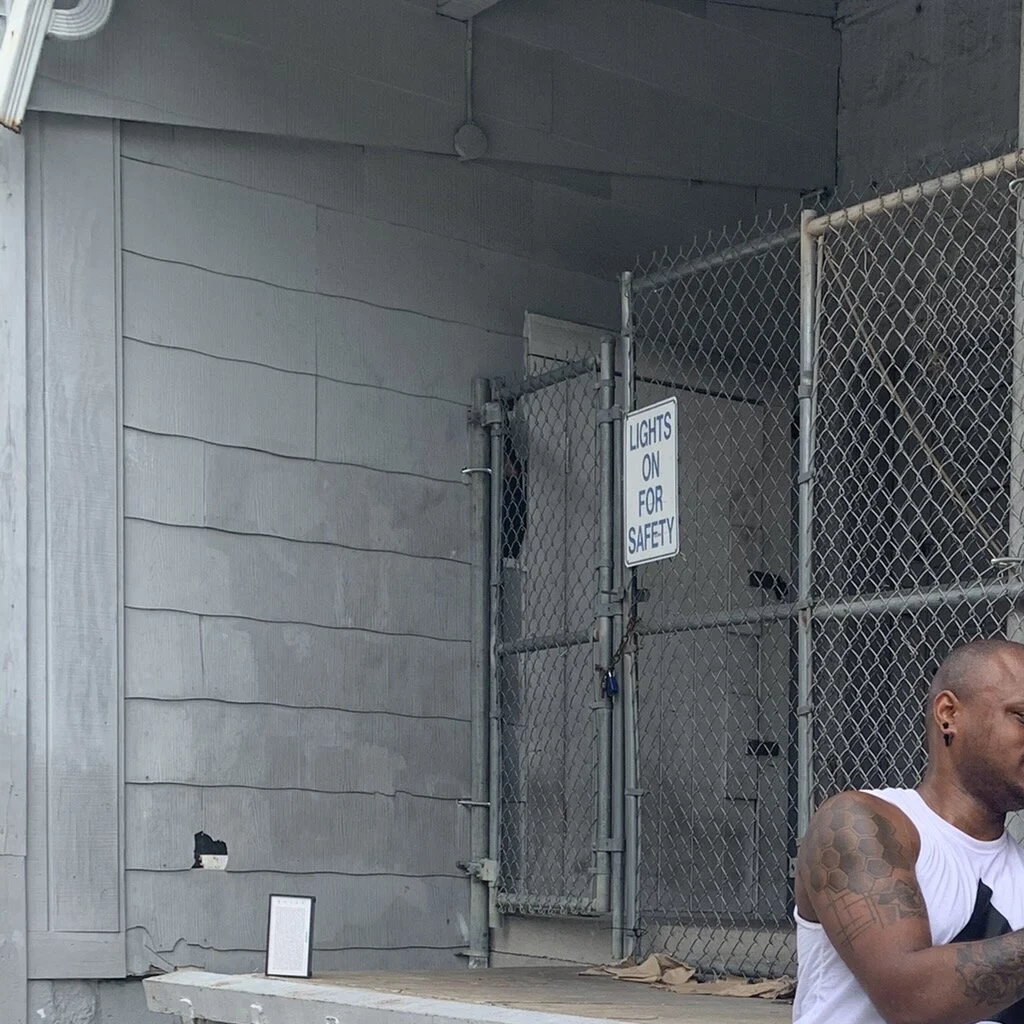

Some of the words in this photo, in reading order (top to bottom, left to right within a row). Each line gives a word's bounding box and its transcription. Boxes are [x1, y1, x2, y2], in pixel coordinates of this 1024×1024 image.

[630, 411, 672, 451] LIGHTS
[642, 451, 660, 482] ON
[638, 485, 663, 517] FOR
[628, 516, 675, 554] SAFETY
